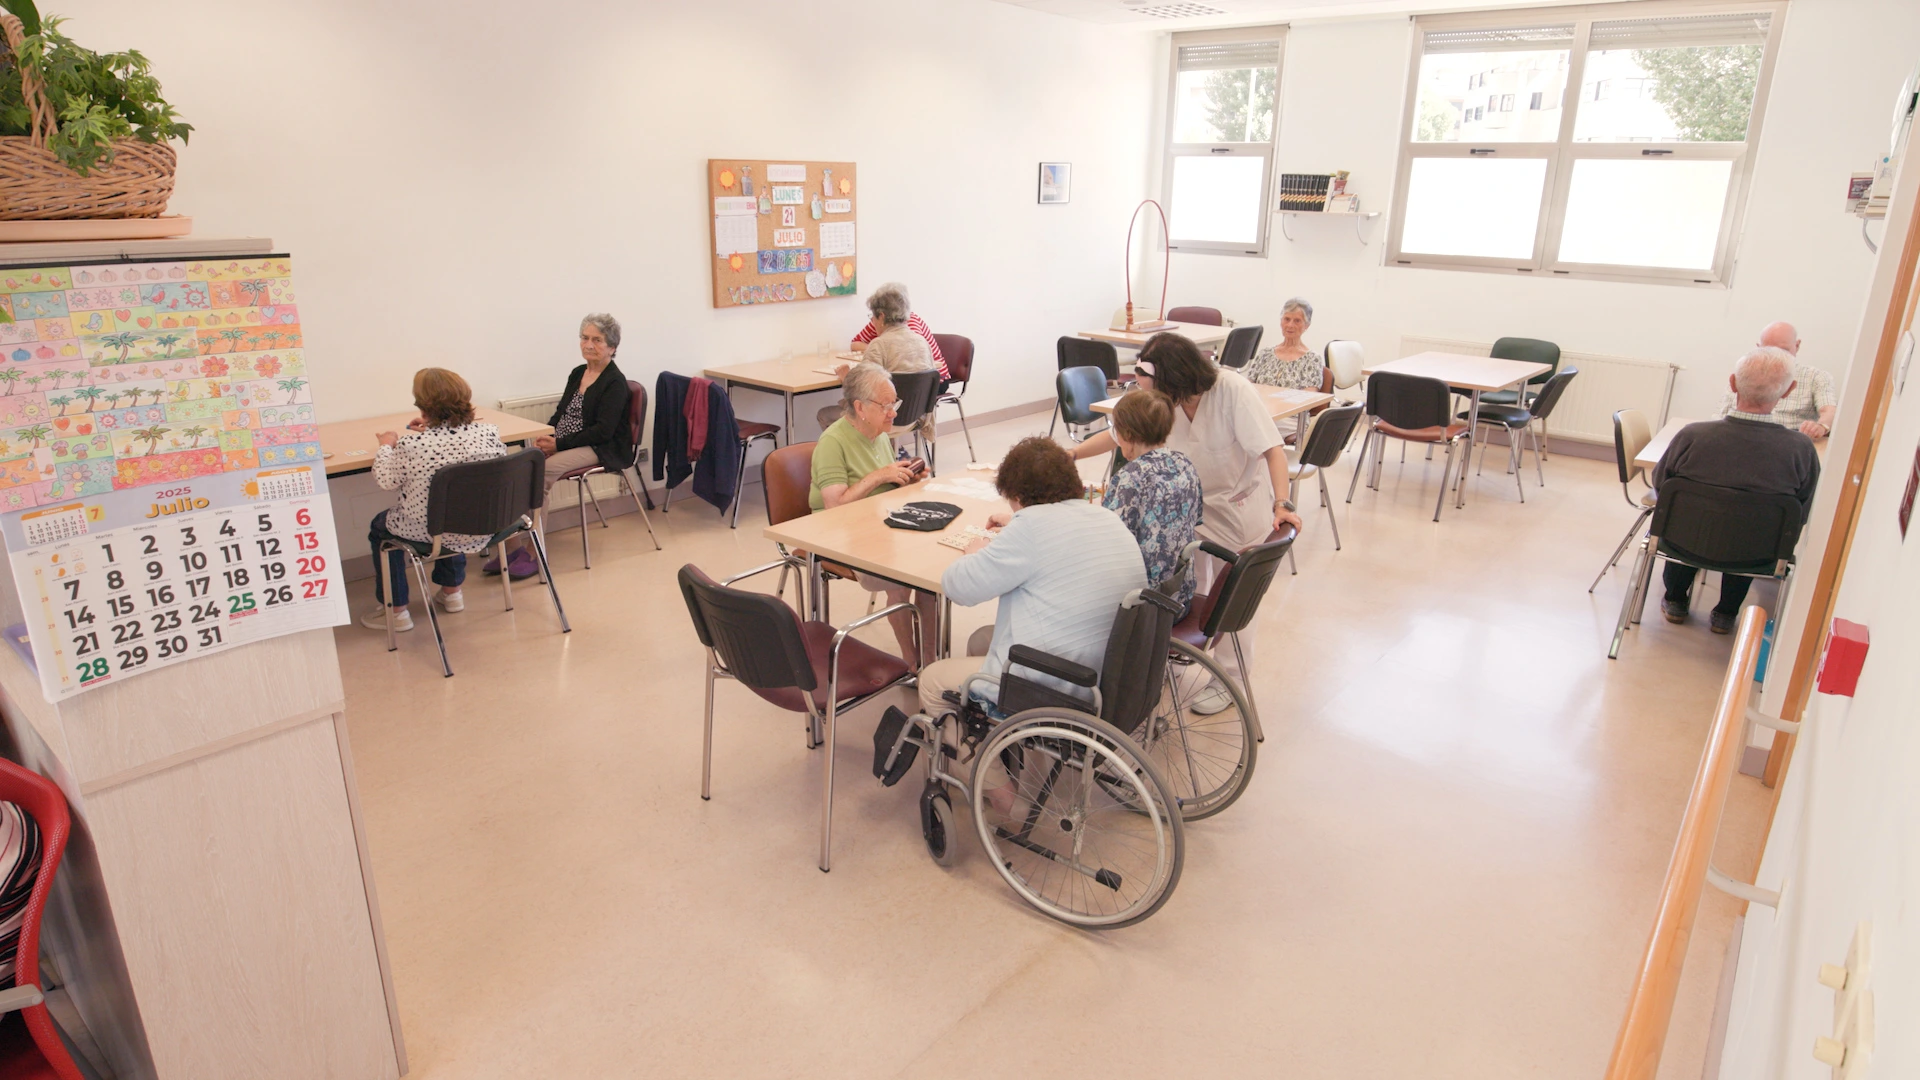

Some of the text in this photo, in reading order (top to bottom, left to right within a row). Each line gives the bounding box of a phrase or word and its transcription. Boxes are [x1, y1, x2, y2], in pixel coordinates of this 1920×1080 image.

[774, 189, 802, 201] LUNES
[784, 208, 794, 224] 21
[776, 231, 803, 244] JULIO
[763, 249, 809, 273] 2025
[727, 283, 797, 305] VERANO
[155, 486, 192, 499] 2025
[90, 507, 100, 521] 7
[144, 495, 210, 520] Julio
[214, 508, 233, 516] Viernes
[101, 543, 115, 562] 1
[140, 534, 158, 555] 2
[180, 526, 197, 546] 3
[219, 519, 236, 537] 4
[257, 513, 273, 532] 5
[295, 507, 312, 526] 6
[63, 579, 80, 601] 7
[106, 570, 125, 590] 8
[146, 561, 163, 581] 9
[179, 551, 207, 573] 10
[219, 543, 242, 564] 11
[255, 537, 282, 557] 12
[294, 531, 319, 551] 13
[64, 605, 96, 630] 14
[106, 594, 135, 618] 15
[146, 584, 175, 607] 16
[185, 575, 211, 598] 17
[222, 568, 250, 589] 18
[259, 561, 286, 581] 19
[296, 555, 326, 576] 20
[72, 631, 100, 656] 21
[110, 620, 144, 645] 22
[150, 609, 182, 634] 23
[188, 600, 221, 624] 24
[227, 592, 256, 613] 25
[262, 584, 294, 606] 26
[301, 578, 329, 599] 27
[76, 657, 109, 683] 28
[116, 645, 149, 671] 29
[155, 635, 188, 658] 30
[197, 625, 222, 647] 31
